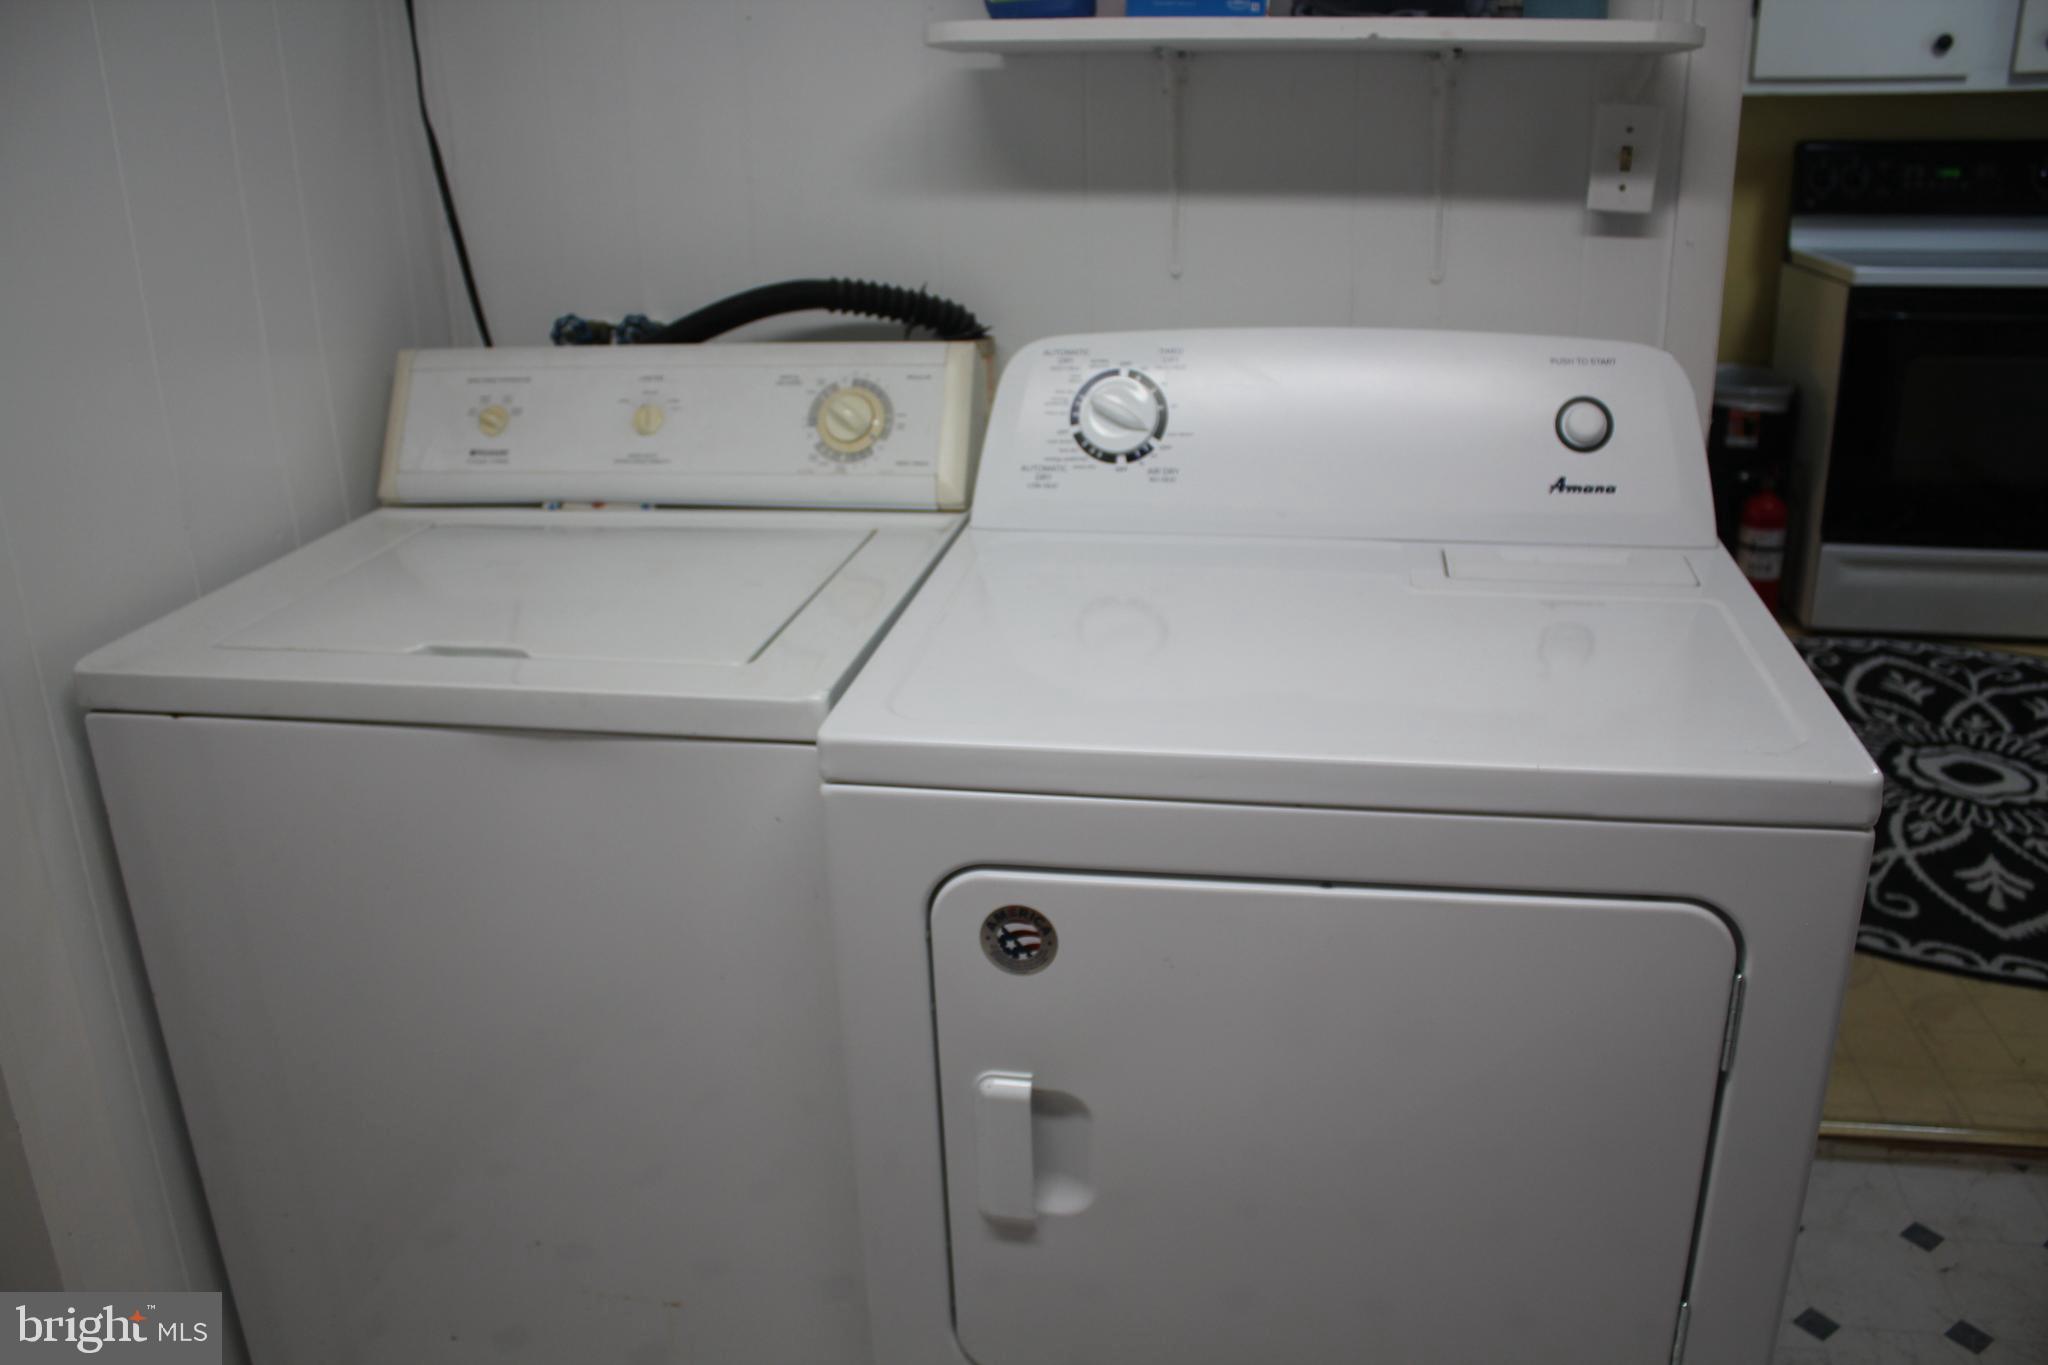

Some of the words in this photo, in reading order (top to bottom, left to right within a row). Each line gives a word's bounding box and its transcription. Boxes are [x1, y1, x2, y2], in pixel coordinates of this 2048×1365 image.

[1550, 357, 1574, 366] PUSH
[1577, 357, 1589, 366] TO
[1590, 357, 1617, 366] START
[1550, 477, 1616, 494] Amana
